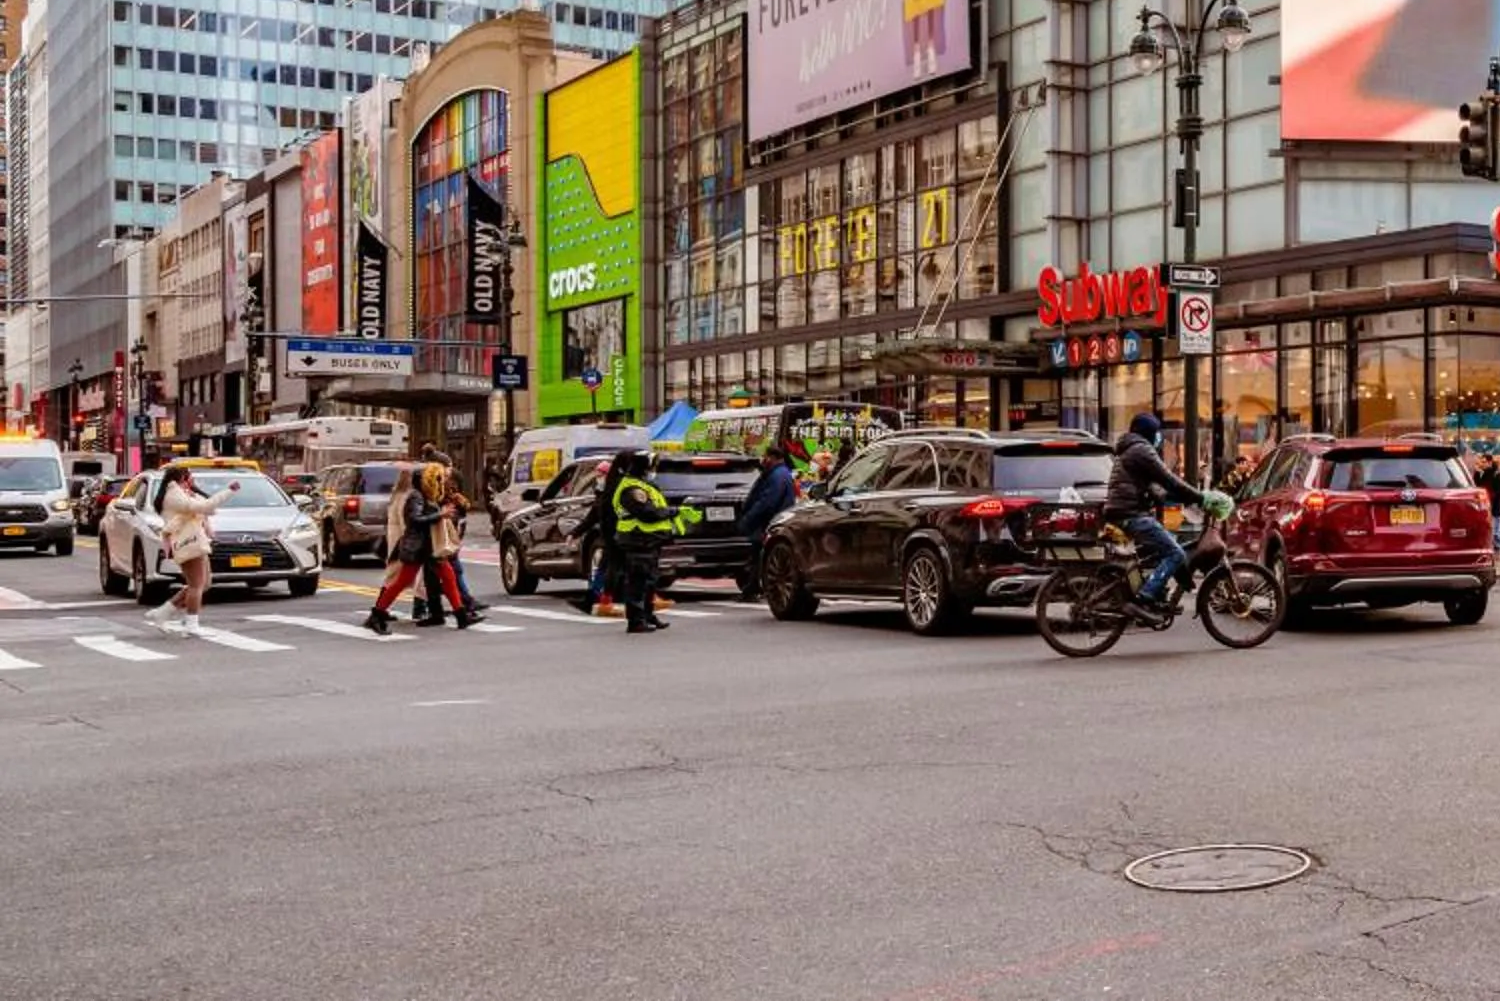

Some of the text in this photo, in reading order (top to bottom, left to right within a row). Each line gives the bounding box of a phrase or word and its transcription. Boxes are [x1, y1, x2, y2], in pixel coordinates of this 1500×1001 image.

[921, 186, 949, 248] 21
[473, 218, 502, 312] OLD NAVY
[549, 262, 597, 299] crocs
[361, 254, 382, 340] OLD NAVY
[1038, 261, 1168, 327] Subway
[331, 358, 401, 370] BUSES ONLY
[1072, 338, 1117, 357] 1 2 3
[612, 358, 625, 407] crocs
